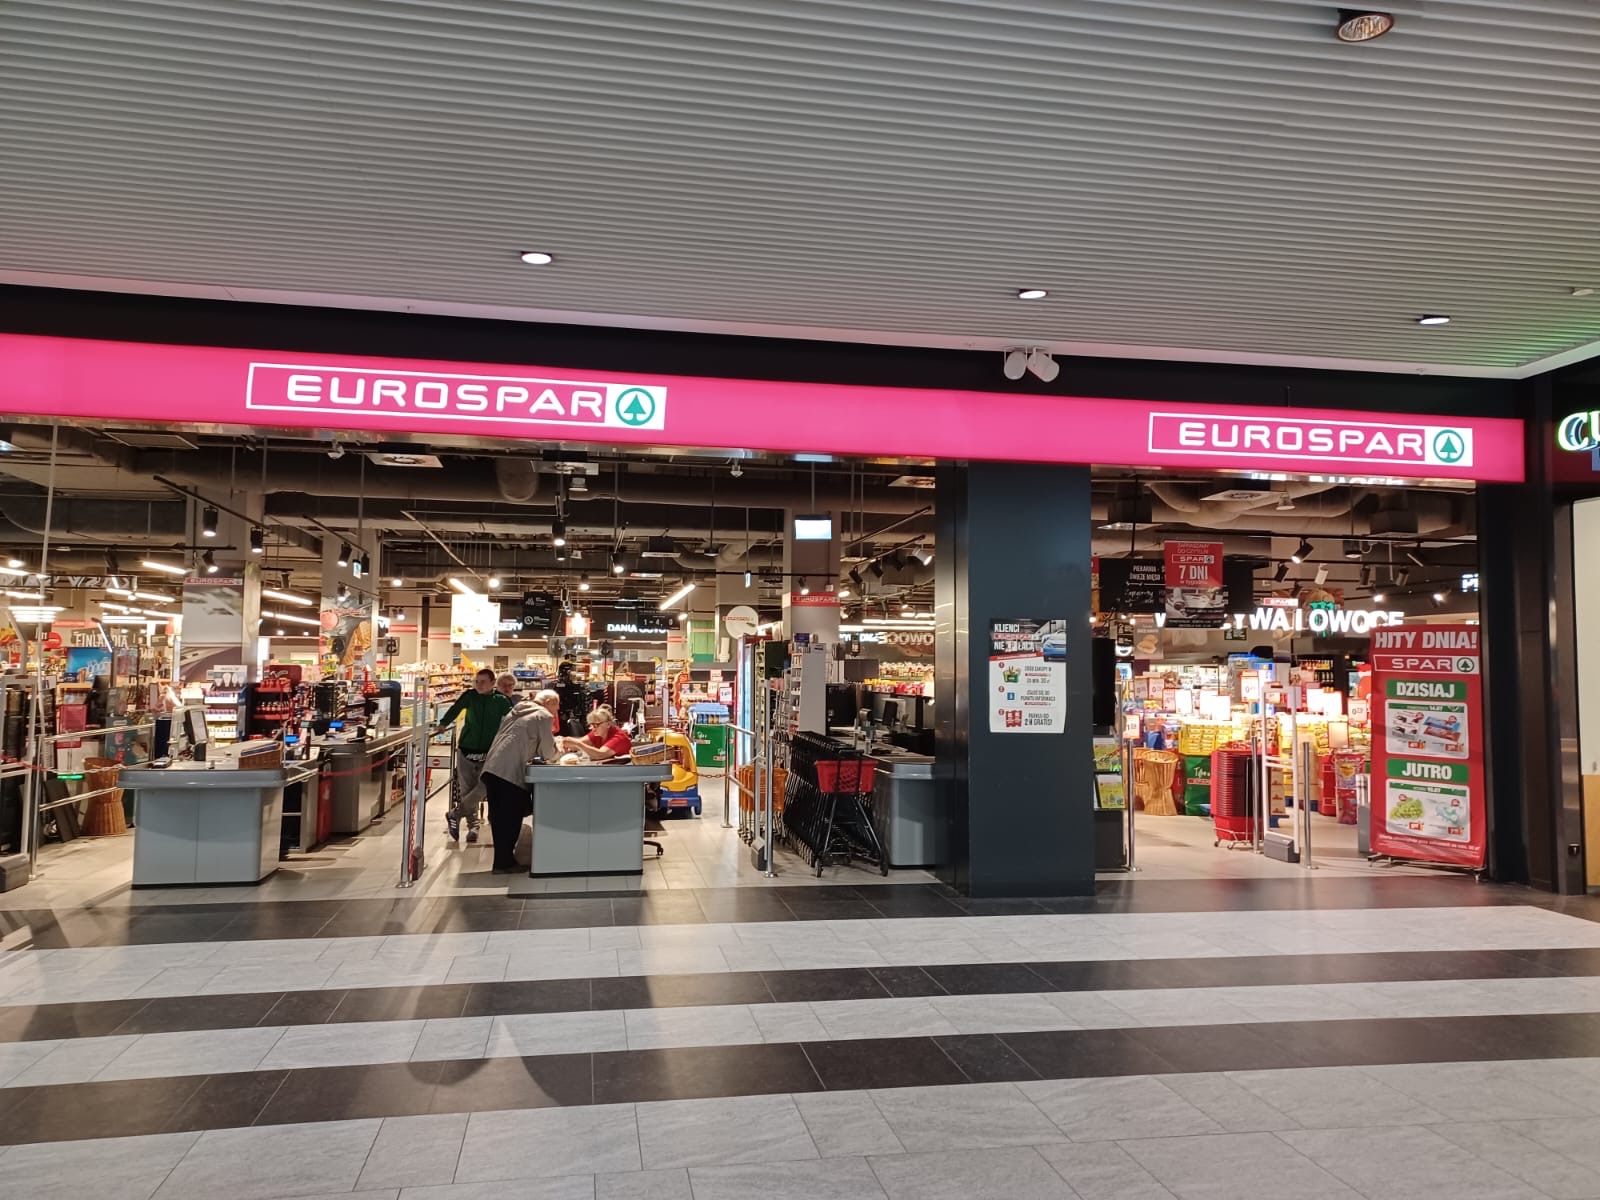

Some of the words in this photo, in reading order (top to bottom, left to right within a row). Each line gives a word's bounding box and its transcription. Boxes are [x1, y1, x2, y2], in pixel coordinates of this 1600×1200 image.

[287, 374, 603, 418] EUROSPAR
[1179, 422, 1423, 456] EUROSPAR
[1179, 565, 1187, 579] 7
[1189, 565, 1209, 580] DNI
[607, 624, 637, 633] DANIA
[994, 623, 1020, 633] KLIENCI
[1309, 610, 1405, 633] OWOCE
[75, 632, 129, 648] FINLADIA
[1375, 631, 1417, 648] HITY
[1422, 631, 1478, 649] DNIA!
[1391, 658, 1452, 670] SPAR
[1396, 681, 1455, 698] DZISIAJ
[1402, 762, 1453, 780] JUTRO
